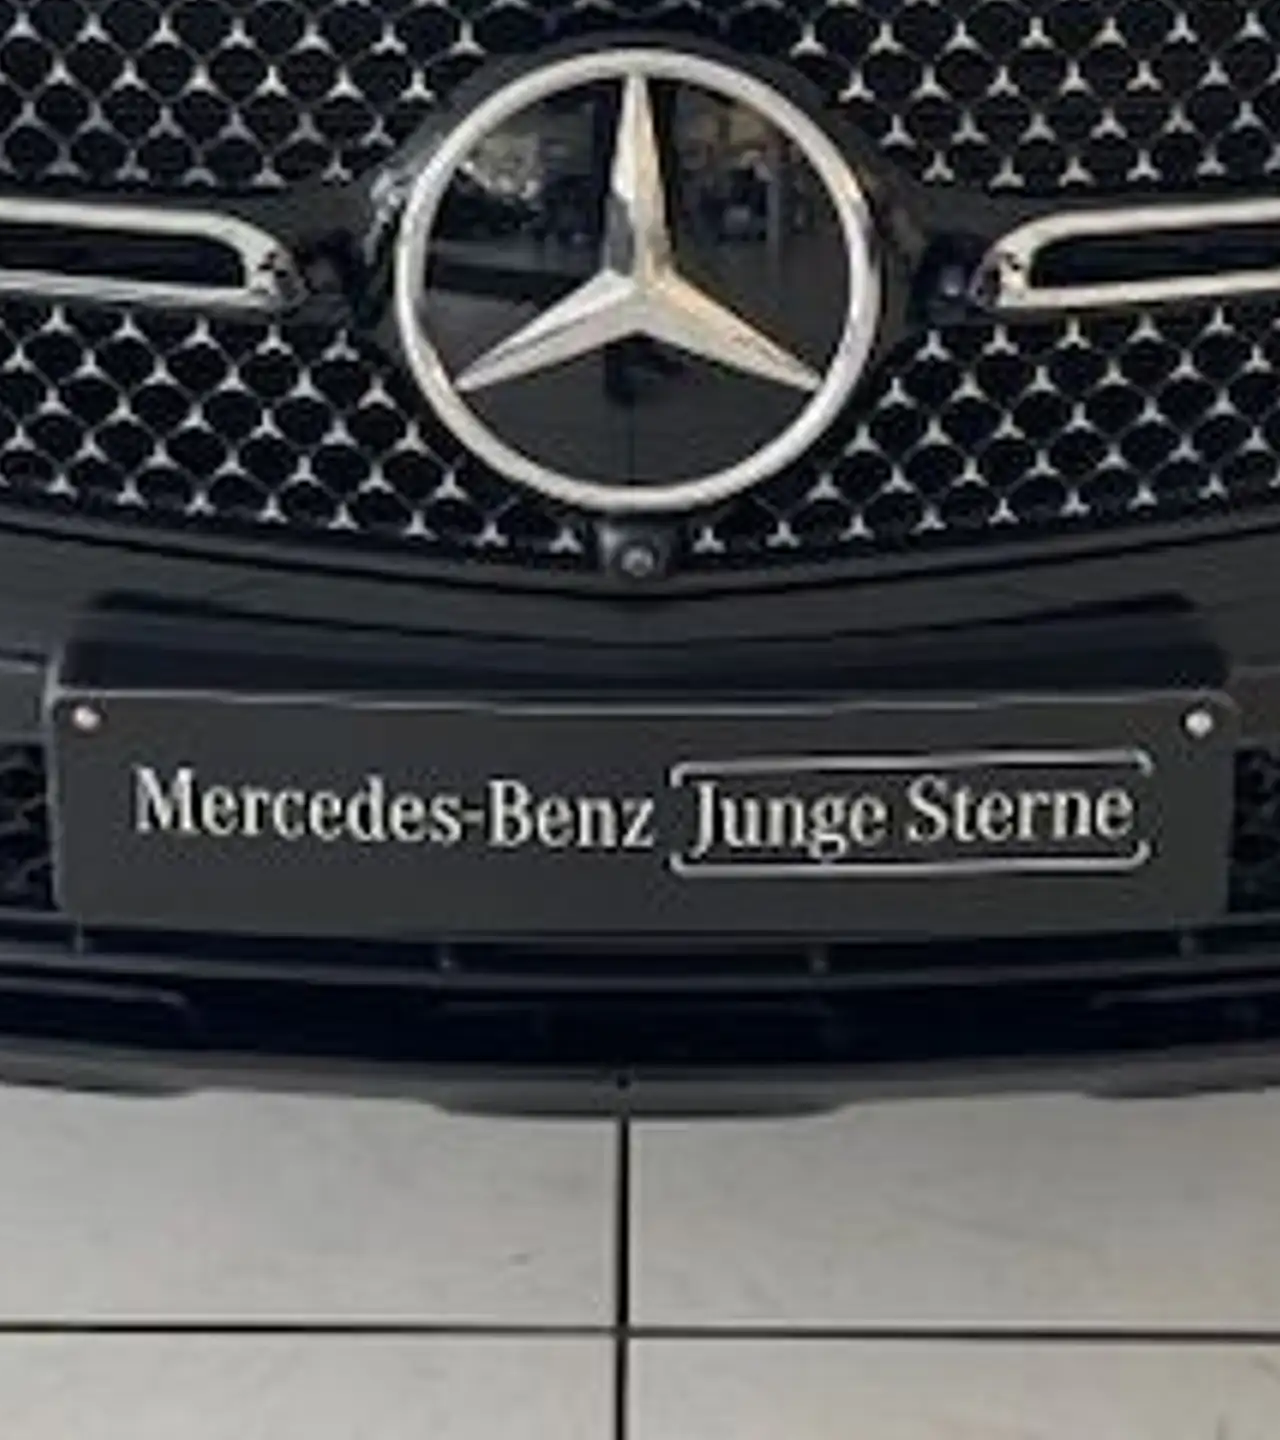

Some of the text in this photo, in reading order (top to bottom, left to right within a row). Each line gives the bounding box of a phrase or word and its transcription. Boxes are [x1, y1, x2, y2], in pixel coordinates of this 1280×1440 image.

[134, 765, 1134, 860] Mercedes-Benz Junge Sterne
